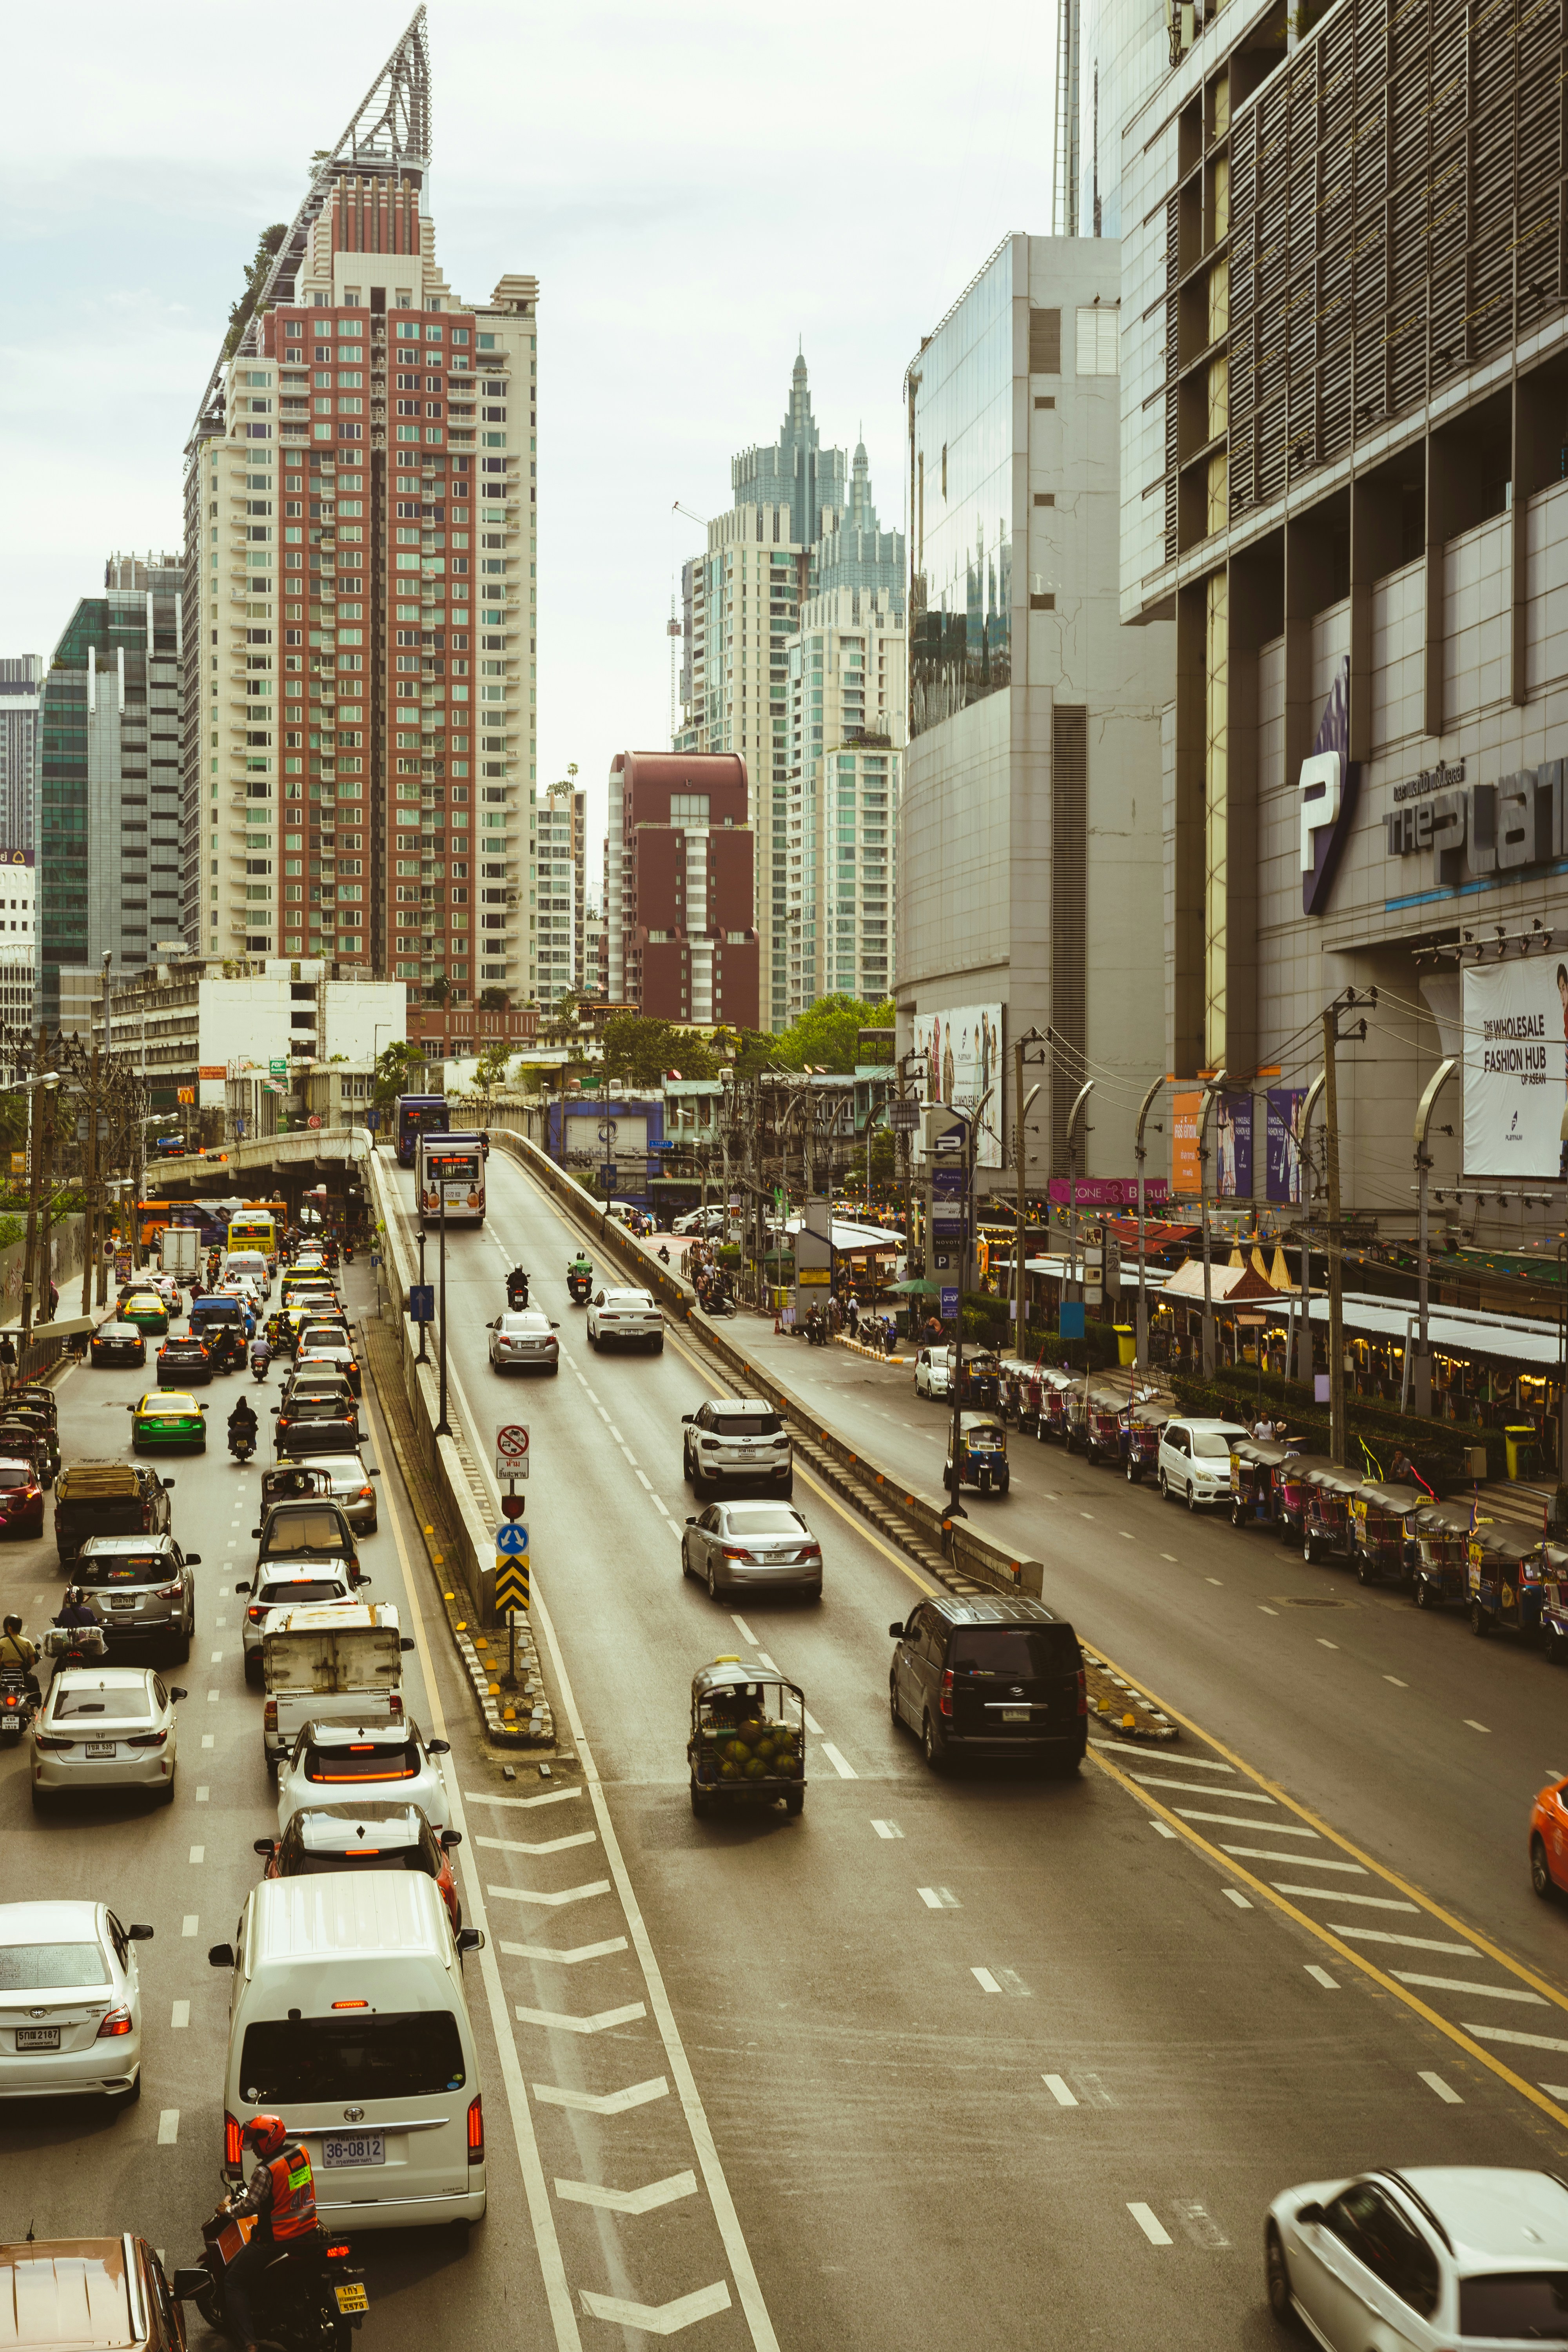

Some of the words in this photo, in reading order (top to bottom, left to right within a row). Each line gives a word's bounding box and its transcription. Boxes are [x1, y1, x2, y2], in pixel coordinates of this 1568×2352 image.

[1484, 1021, 1493, 1032] THE
[1494, 1014, 1545, 1040] WHOLESALE
[1484, 1048, 1523, 1073] FASHION
[1525, 1046, 1546, 1069] HUB
[1521, 1074, 1528, 1085] OF
[1529, 1073, 1546, 1085] ASEAN
[1268, 1127, 1278, 1136] FASHION
[1104, 1180, 1125, 1205] 3
[939, 1256, 946, 1267] P
[1108, 1257, 1119, 1273] 2
[506, 1458, 520, 1467] ห้าม
[499, 1468, 526, 1477] ขึ้นสะพาน
[38, 2030, 58, 2040] 2187
[327, 2140, 381, 2158] 36-0812
[336, 2158, 372, 2166] กรุงเทพมหานคร
[290, 2182, 315, 2210] 42
[343, 2302, 364, 2311] 5579
